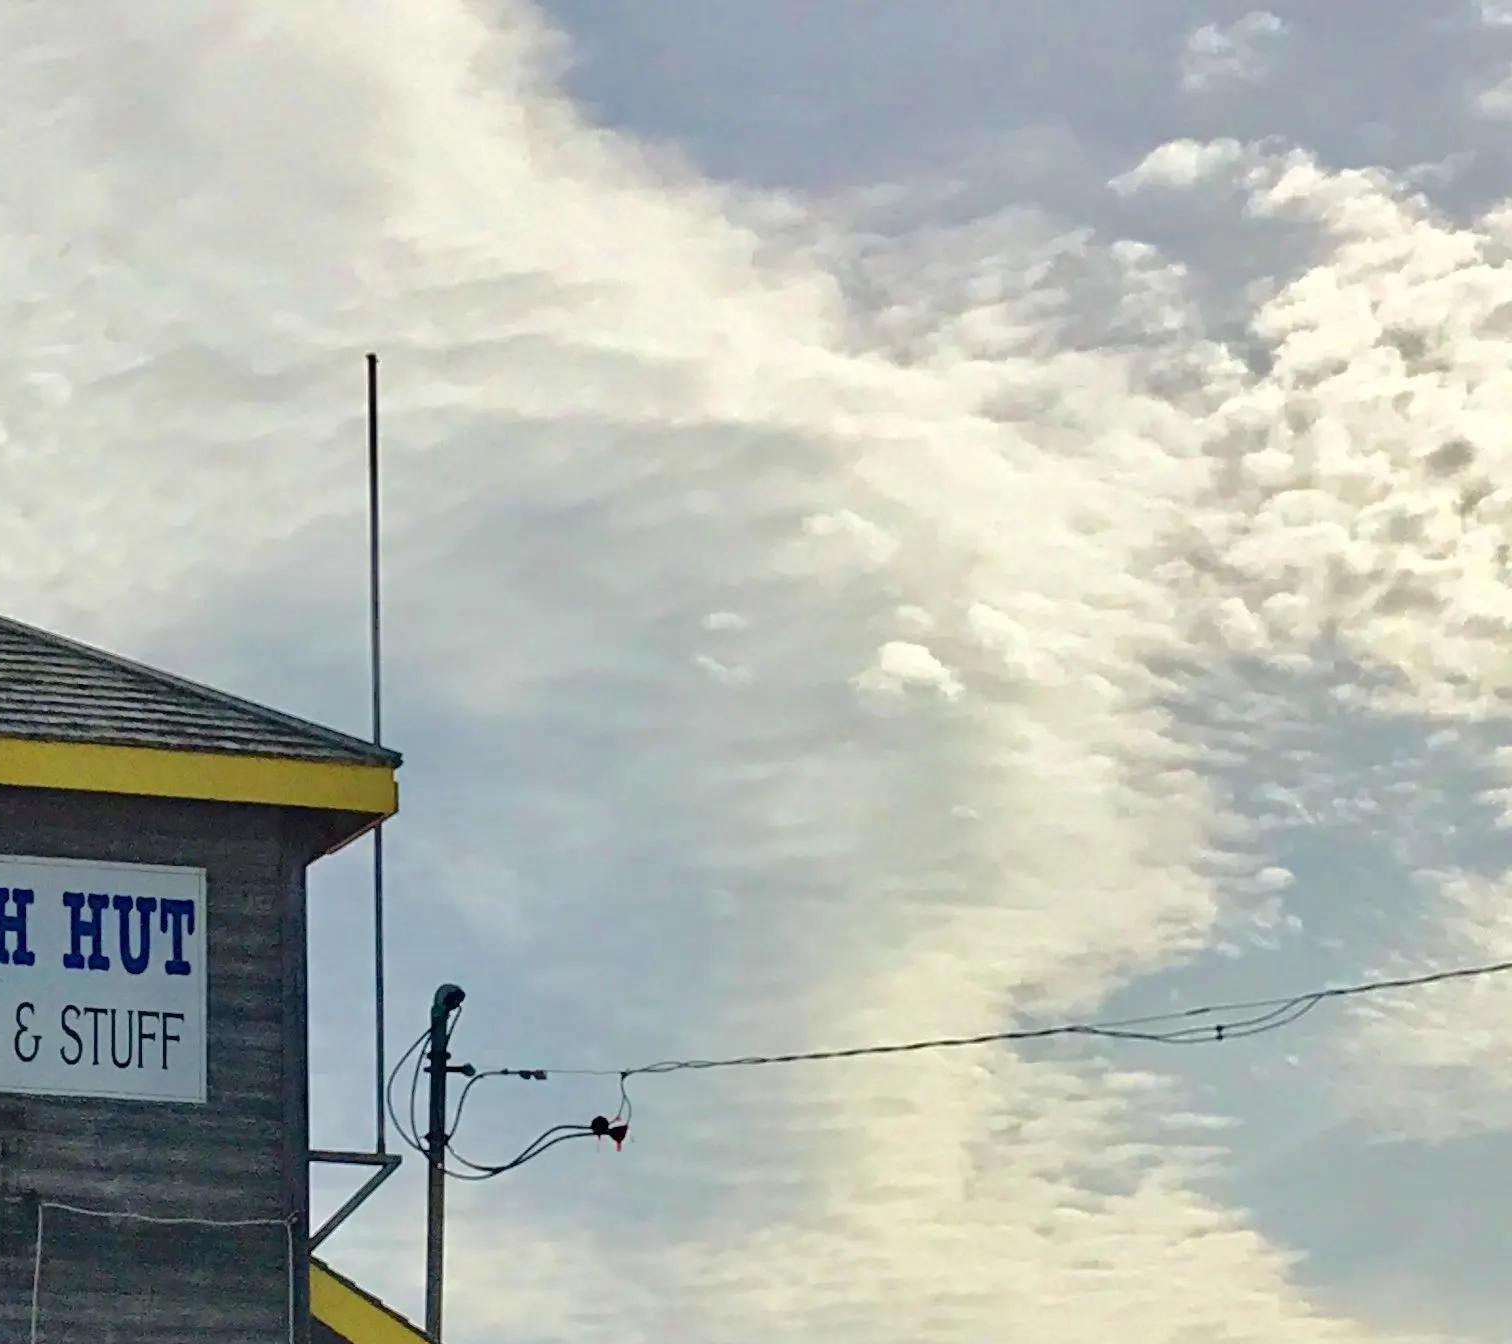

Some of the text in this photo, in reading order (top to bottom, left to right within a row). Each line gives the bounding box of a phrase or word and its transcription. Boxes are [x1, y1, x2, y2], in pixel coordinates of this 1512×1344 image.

[62, 890, 196, 977] HUT
[13, 1001, 43, 1063] &
[59, 1004, 185, 1071] STUFF
